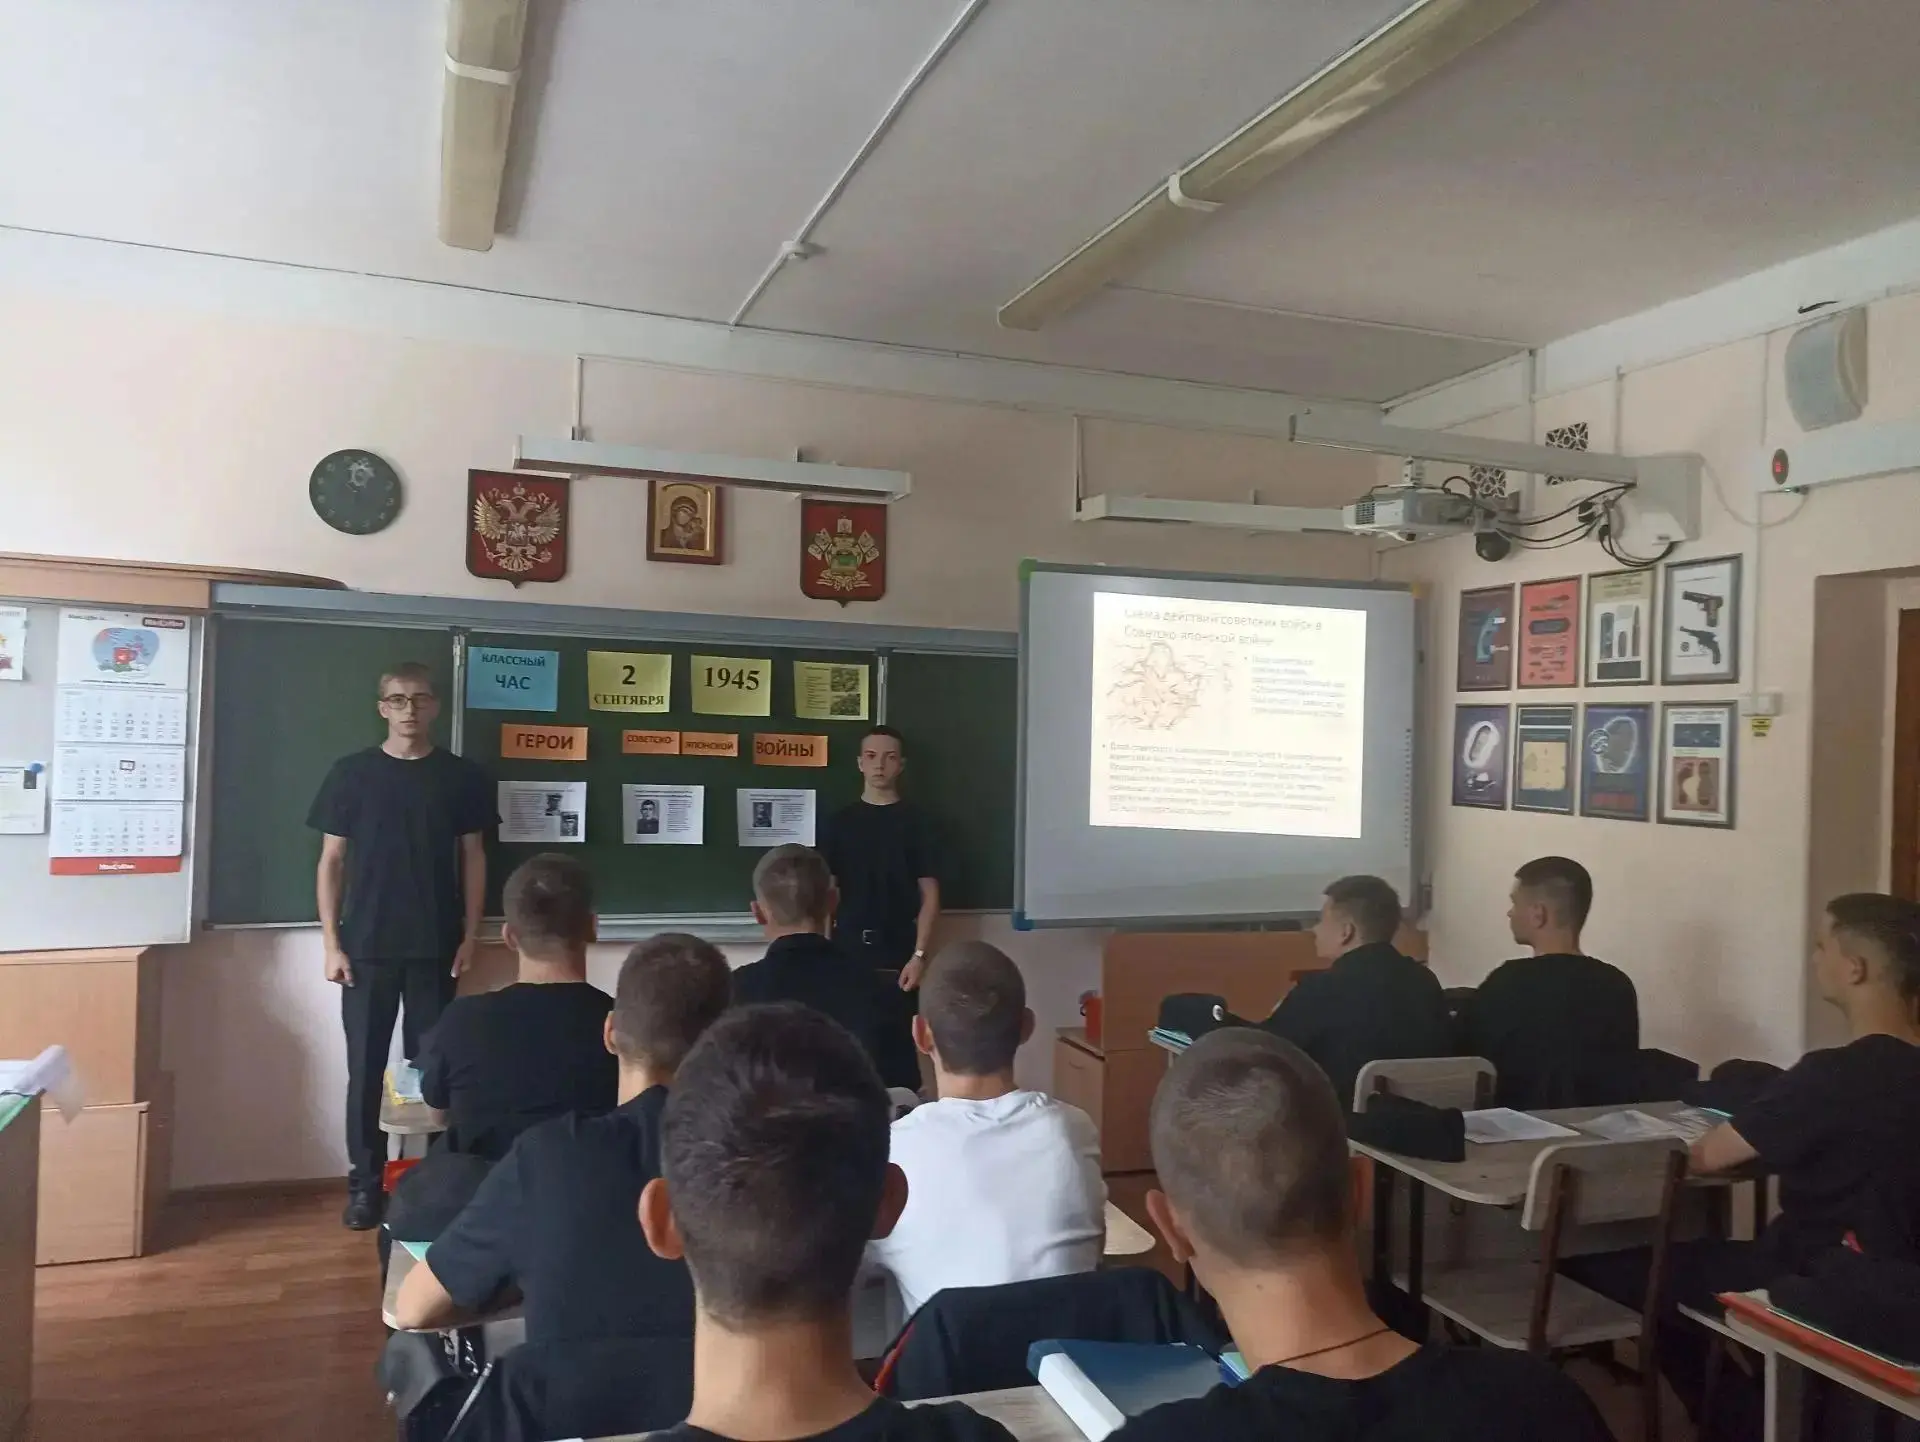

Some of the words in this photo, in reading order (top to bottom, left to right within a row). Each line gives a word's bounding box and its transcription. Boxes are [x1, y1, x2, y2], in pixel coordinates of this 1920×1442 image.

[1239, 633, 1275, 646] вой
[481, 654, 546, 667] КЛАССНЫЙ
[495, 674, 531, 690] ЧАС
[621, 665, 637, 685] 2
[703, 667, 761, 691] 1945
[593, 694, 665, 706] СЕНТЯБРЯ
[516, 732, 575, 750] ГЕРОИ
[684, 741, 734, 750] ЯПОНСКОЙ
[755, 739, 815, 758] ВОЙНЫ
